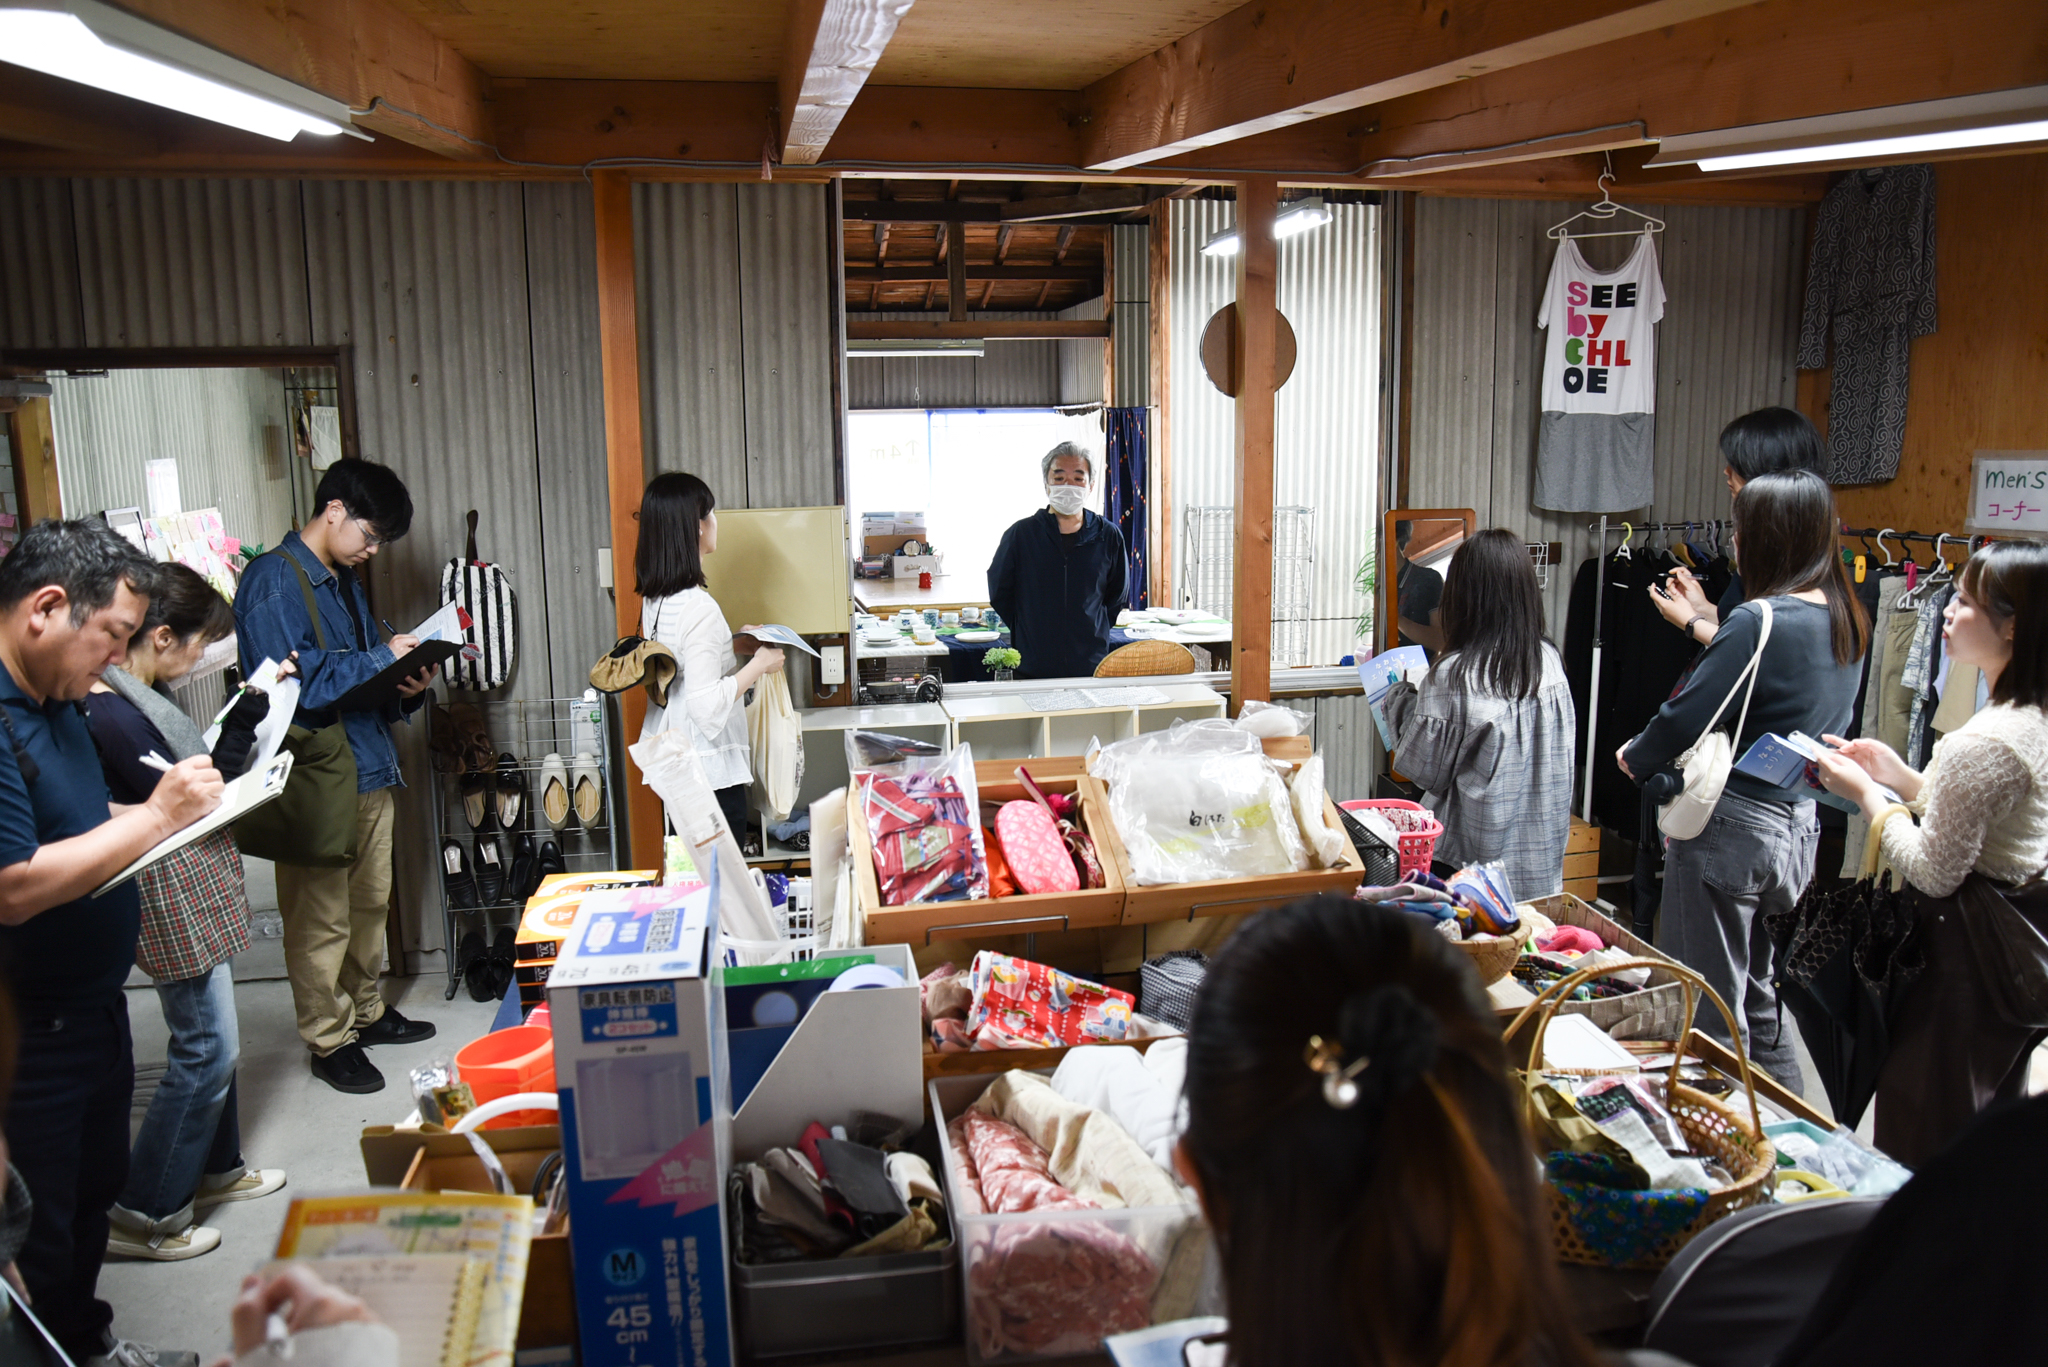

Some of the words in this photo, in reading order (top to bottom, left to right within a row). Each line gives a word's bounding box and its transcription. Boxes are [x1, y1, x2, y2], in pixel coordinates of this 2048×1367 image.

[1567, 281, 1637, 309] SEE
[1565, 338, 1631, 367] CHL
[1563, 366, 1609, 394] OE
[1988, 501, 2041, 521] コーナー
[611, 1252, 636, 1272] M
[606, 1304, 652, 1328] 45
[615, 1328, 648, 1345] cm
